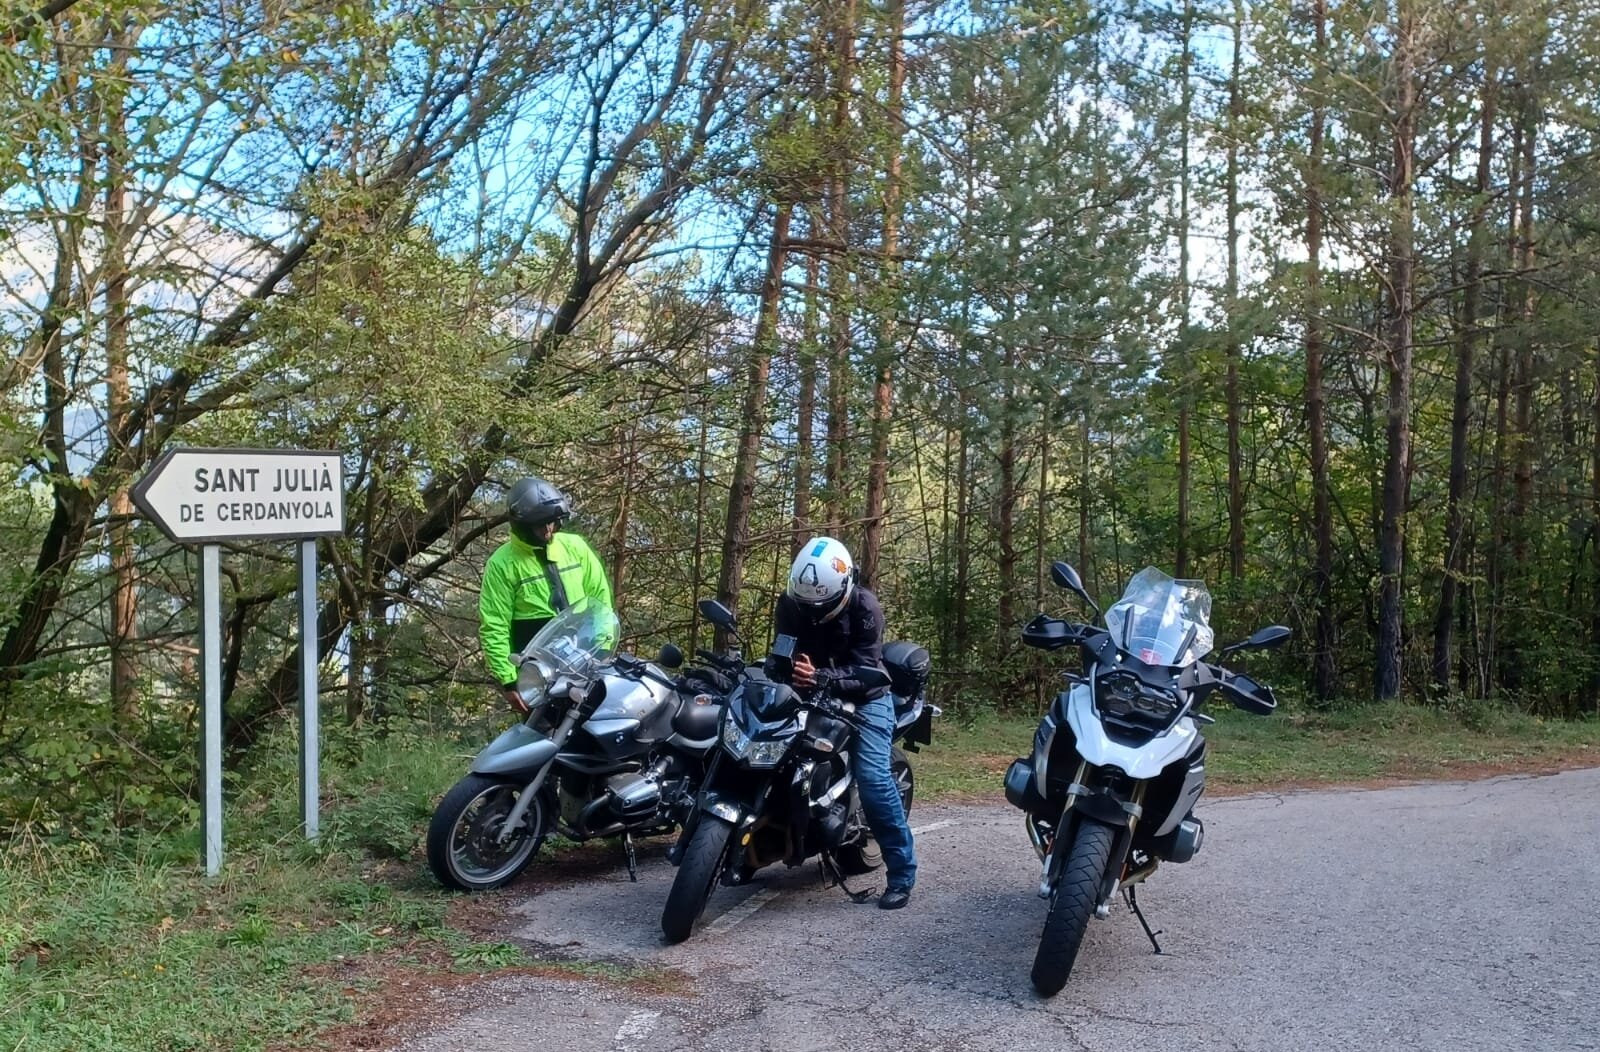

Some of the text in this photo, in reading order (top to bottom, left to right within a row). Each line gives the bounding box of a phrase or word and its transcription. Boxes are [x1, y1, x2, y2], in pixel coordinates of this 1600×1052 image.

[194, 463, 333, 492] SANT JULIÀ
[180, 501, 334, 522] DE CERDANYOLA
